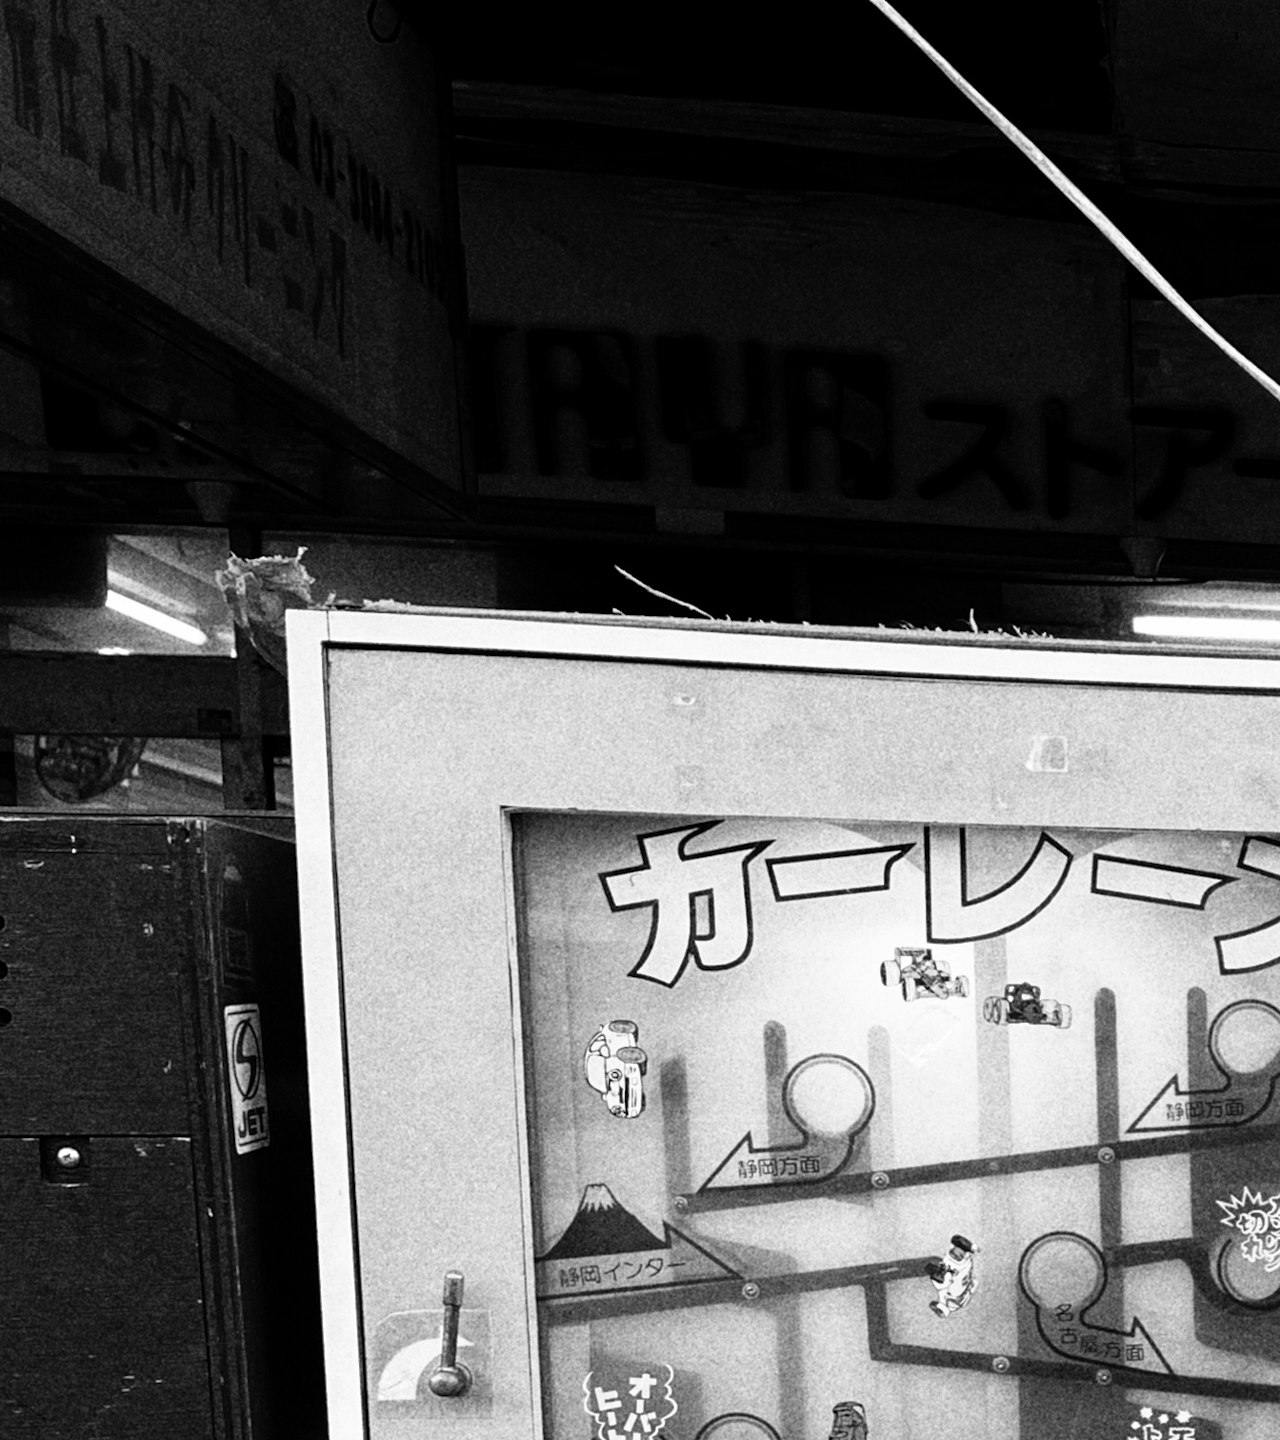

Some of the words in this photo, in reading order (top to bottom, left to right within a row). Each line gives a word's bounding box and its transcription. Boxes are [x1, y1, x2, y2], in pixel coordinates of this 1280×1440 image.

[239, 1106, 266, 1138] JET
[1166, 1098, 1244, 1121] 静岡方面
[737, 1155, 822, 1179] 静岡方面
[558, 1257, 687, 1287] 静岡インター
[1054, 1303, 1145, 1362] 名古屋方面
